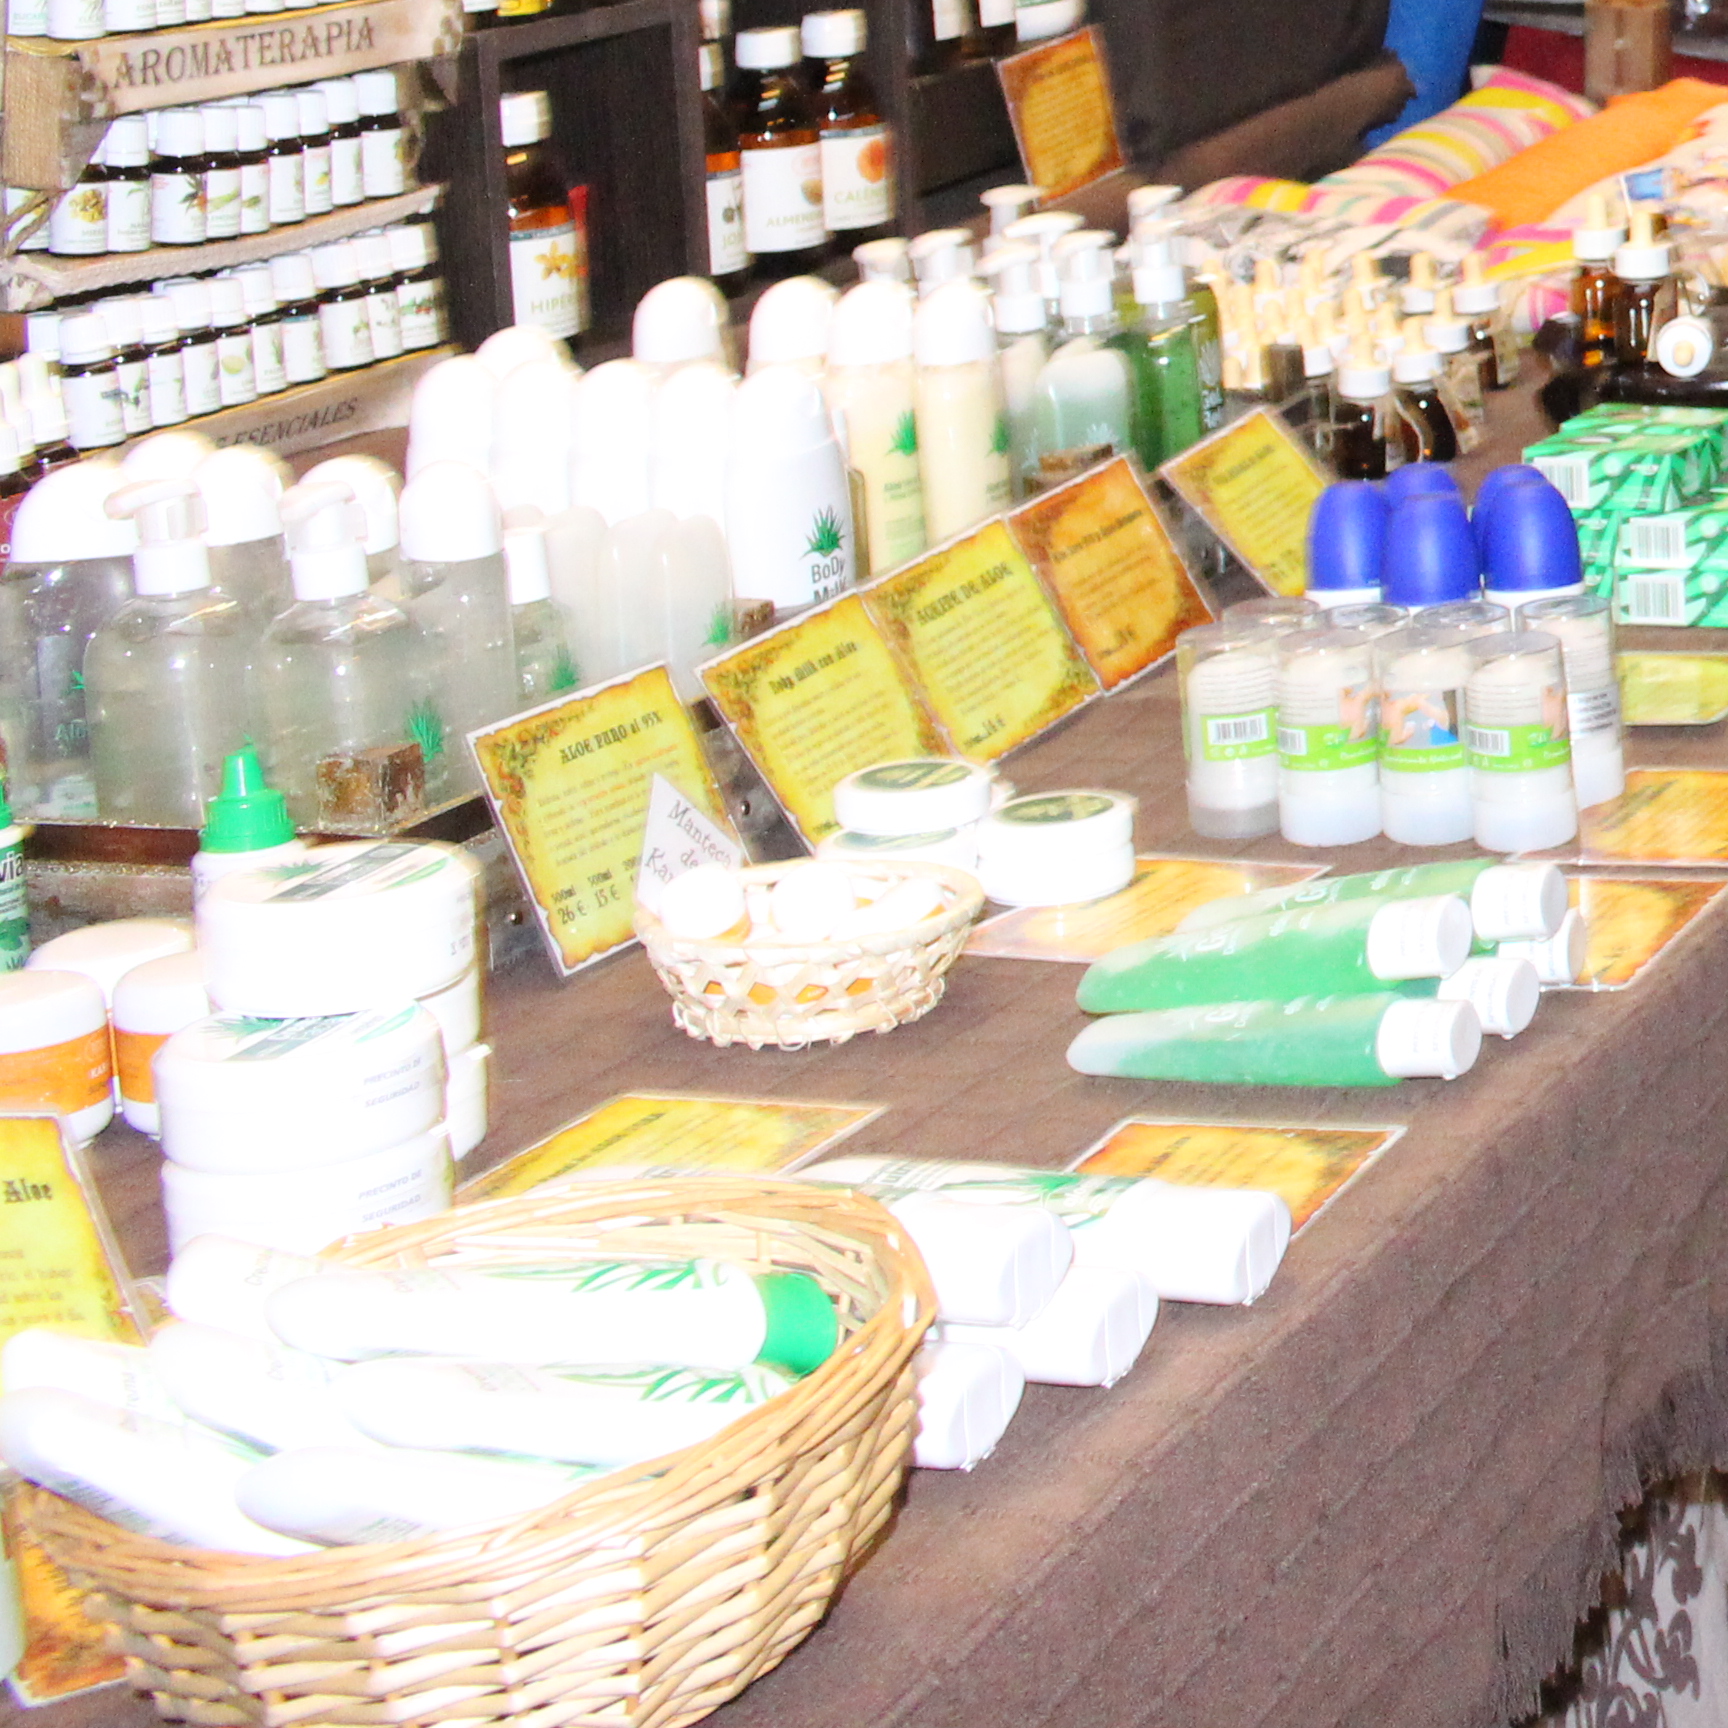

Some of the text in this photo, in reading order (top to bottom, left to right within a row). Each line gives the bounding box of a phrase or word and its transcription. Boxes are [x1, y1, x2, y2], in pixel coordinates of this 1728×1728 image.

[113, 16, 375, 89] AROMATERAPIA
[234, 397, 358, 447] ESENCIALES
[560, 741, 594, 764] ALOE
[596, 725, 629, 751] PURO
[667, 800, 732, 869] Manteca
[680, 846, 699, 869] de
[557, 883, 621, 925] 26 € 15 €
[2, 1177, 53, 1204] Aloe
[358, 1175, 409, 1201] PRECINTO
[361, 1194, 422, 1223] SEGURIDAD
